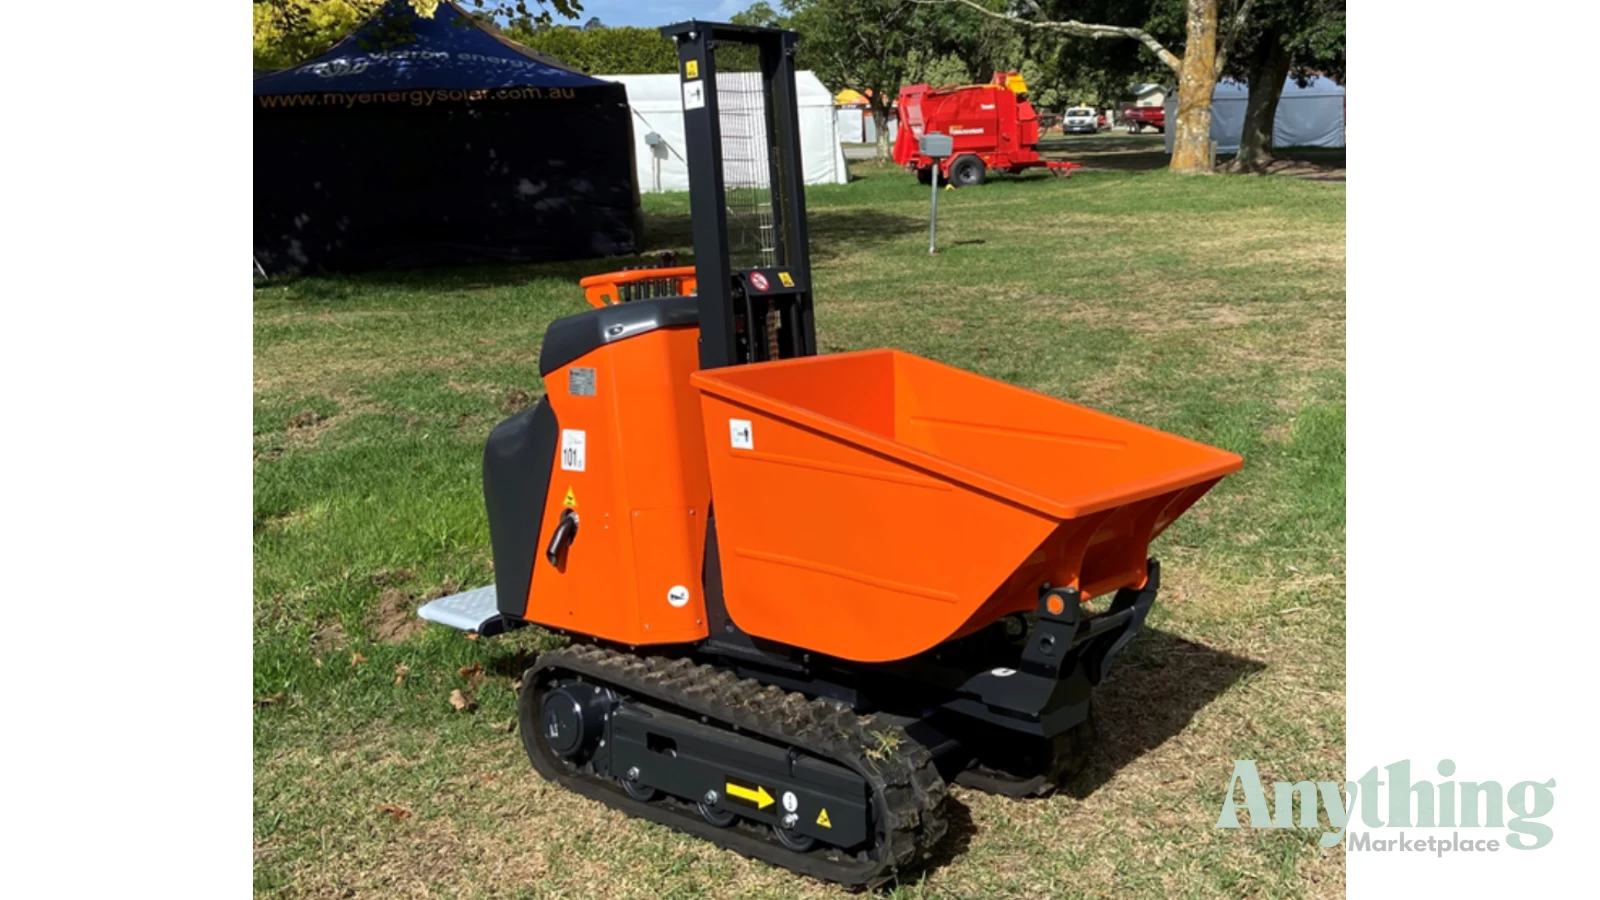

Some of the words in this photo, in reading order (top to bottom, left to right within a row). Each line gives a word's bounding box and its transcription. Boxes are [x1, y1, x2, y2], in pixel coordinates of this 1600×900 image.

[457, 52, 537, 69] energy
[259, 86, 576, 109] www.myenergysolar.com.au
[563, 447, 577, 468] 101
